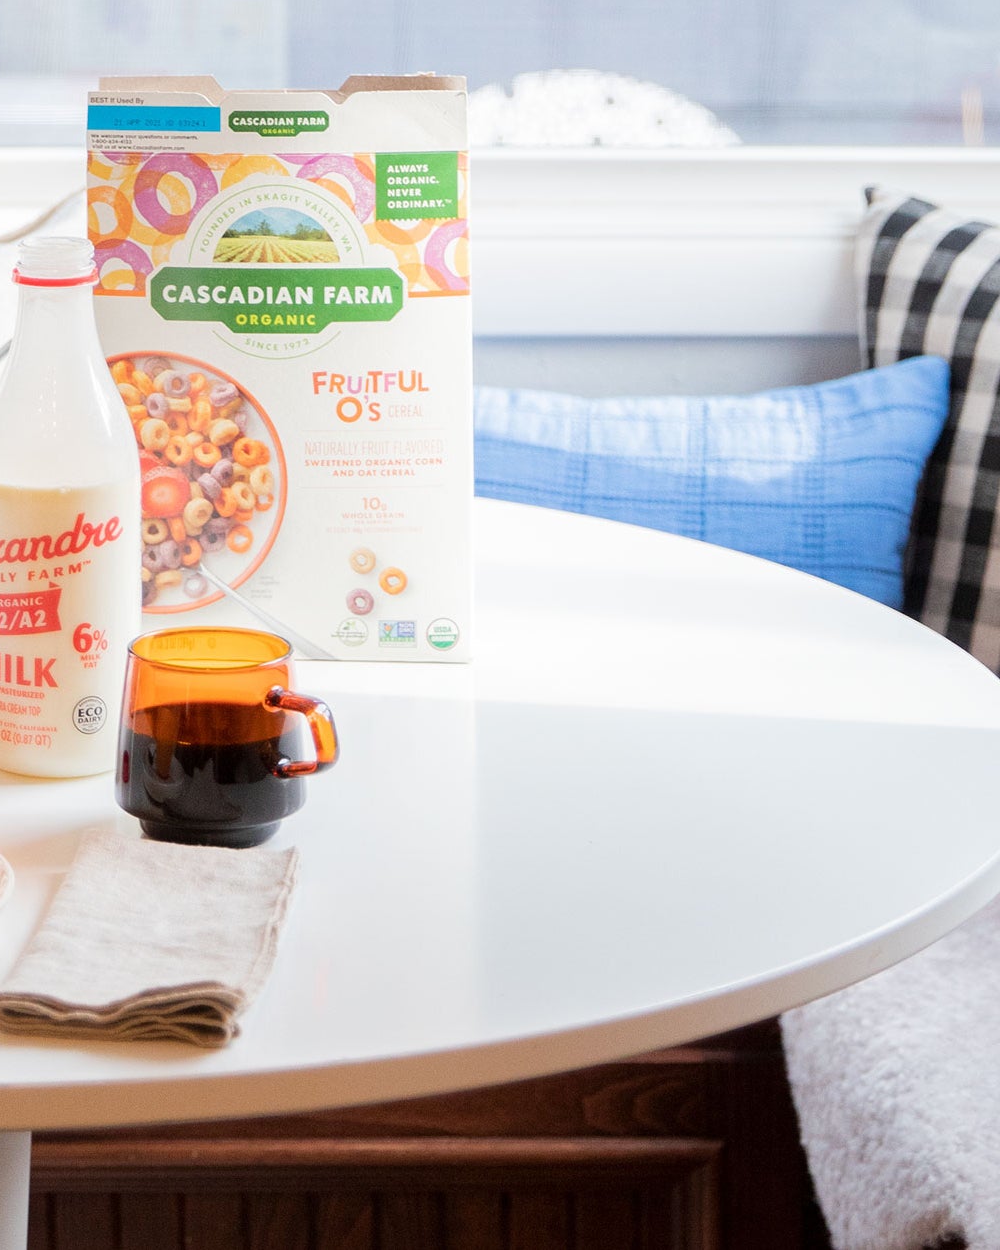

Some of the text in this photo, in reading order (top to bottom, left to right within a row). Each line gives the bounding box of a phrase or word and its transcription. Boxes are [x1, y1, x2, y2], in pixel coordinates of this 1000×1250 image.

[232, 117, 326, 126] CASCADIAN FARM
[387, 164, 429, 173] ALWAYS
[387, 176, 440, 185] ORGANIC.
[387, 188, 422, 197] NEVER
[200, 206, 236, 253] FOUNDED
[239, 198, 252, 208] IN
[256, 192, 301, 203] SKAGIT
[340, 236, 353, 253] WA
[162, 284, 393, 305] CASCADIAN FARM
[235, 313, 317, 326] ORGANIC
[244, 337, 278, 351] SINCE
[304, 441, 359, 457] NATURALLY
[304, 459, 362, 467] SWEETENED
[365, 458, 412, 466] ORGANIC
[72, 622, 108, 653] 6%
[80, 653, 101, 661] MILK
[6, 702, 28, 715] CREAM
[28, 706, 42, 716] TOP
[78, 706, 103, 718] ECO
[78, 716, 102, 724] DAIRY
[19, 724, 58, 732] CALIFORNIA
[0, 729, 12, 742] OZ
[12, 732, 32, 745] (0.87
[34, 734, 52, 748] QT)
